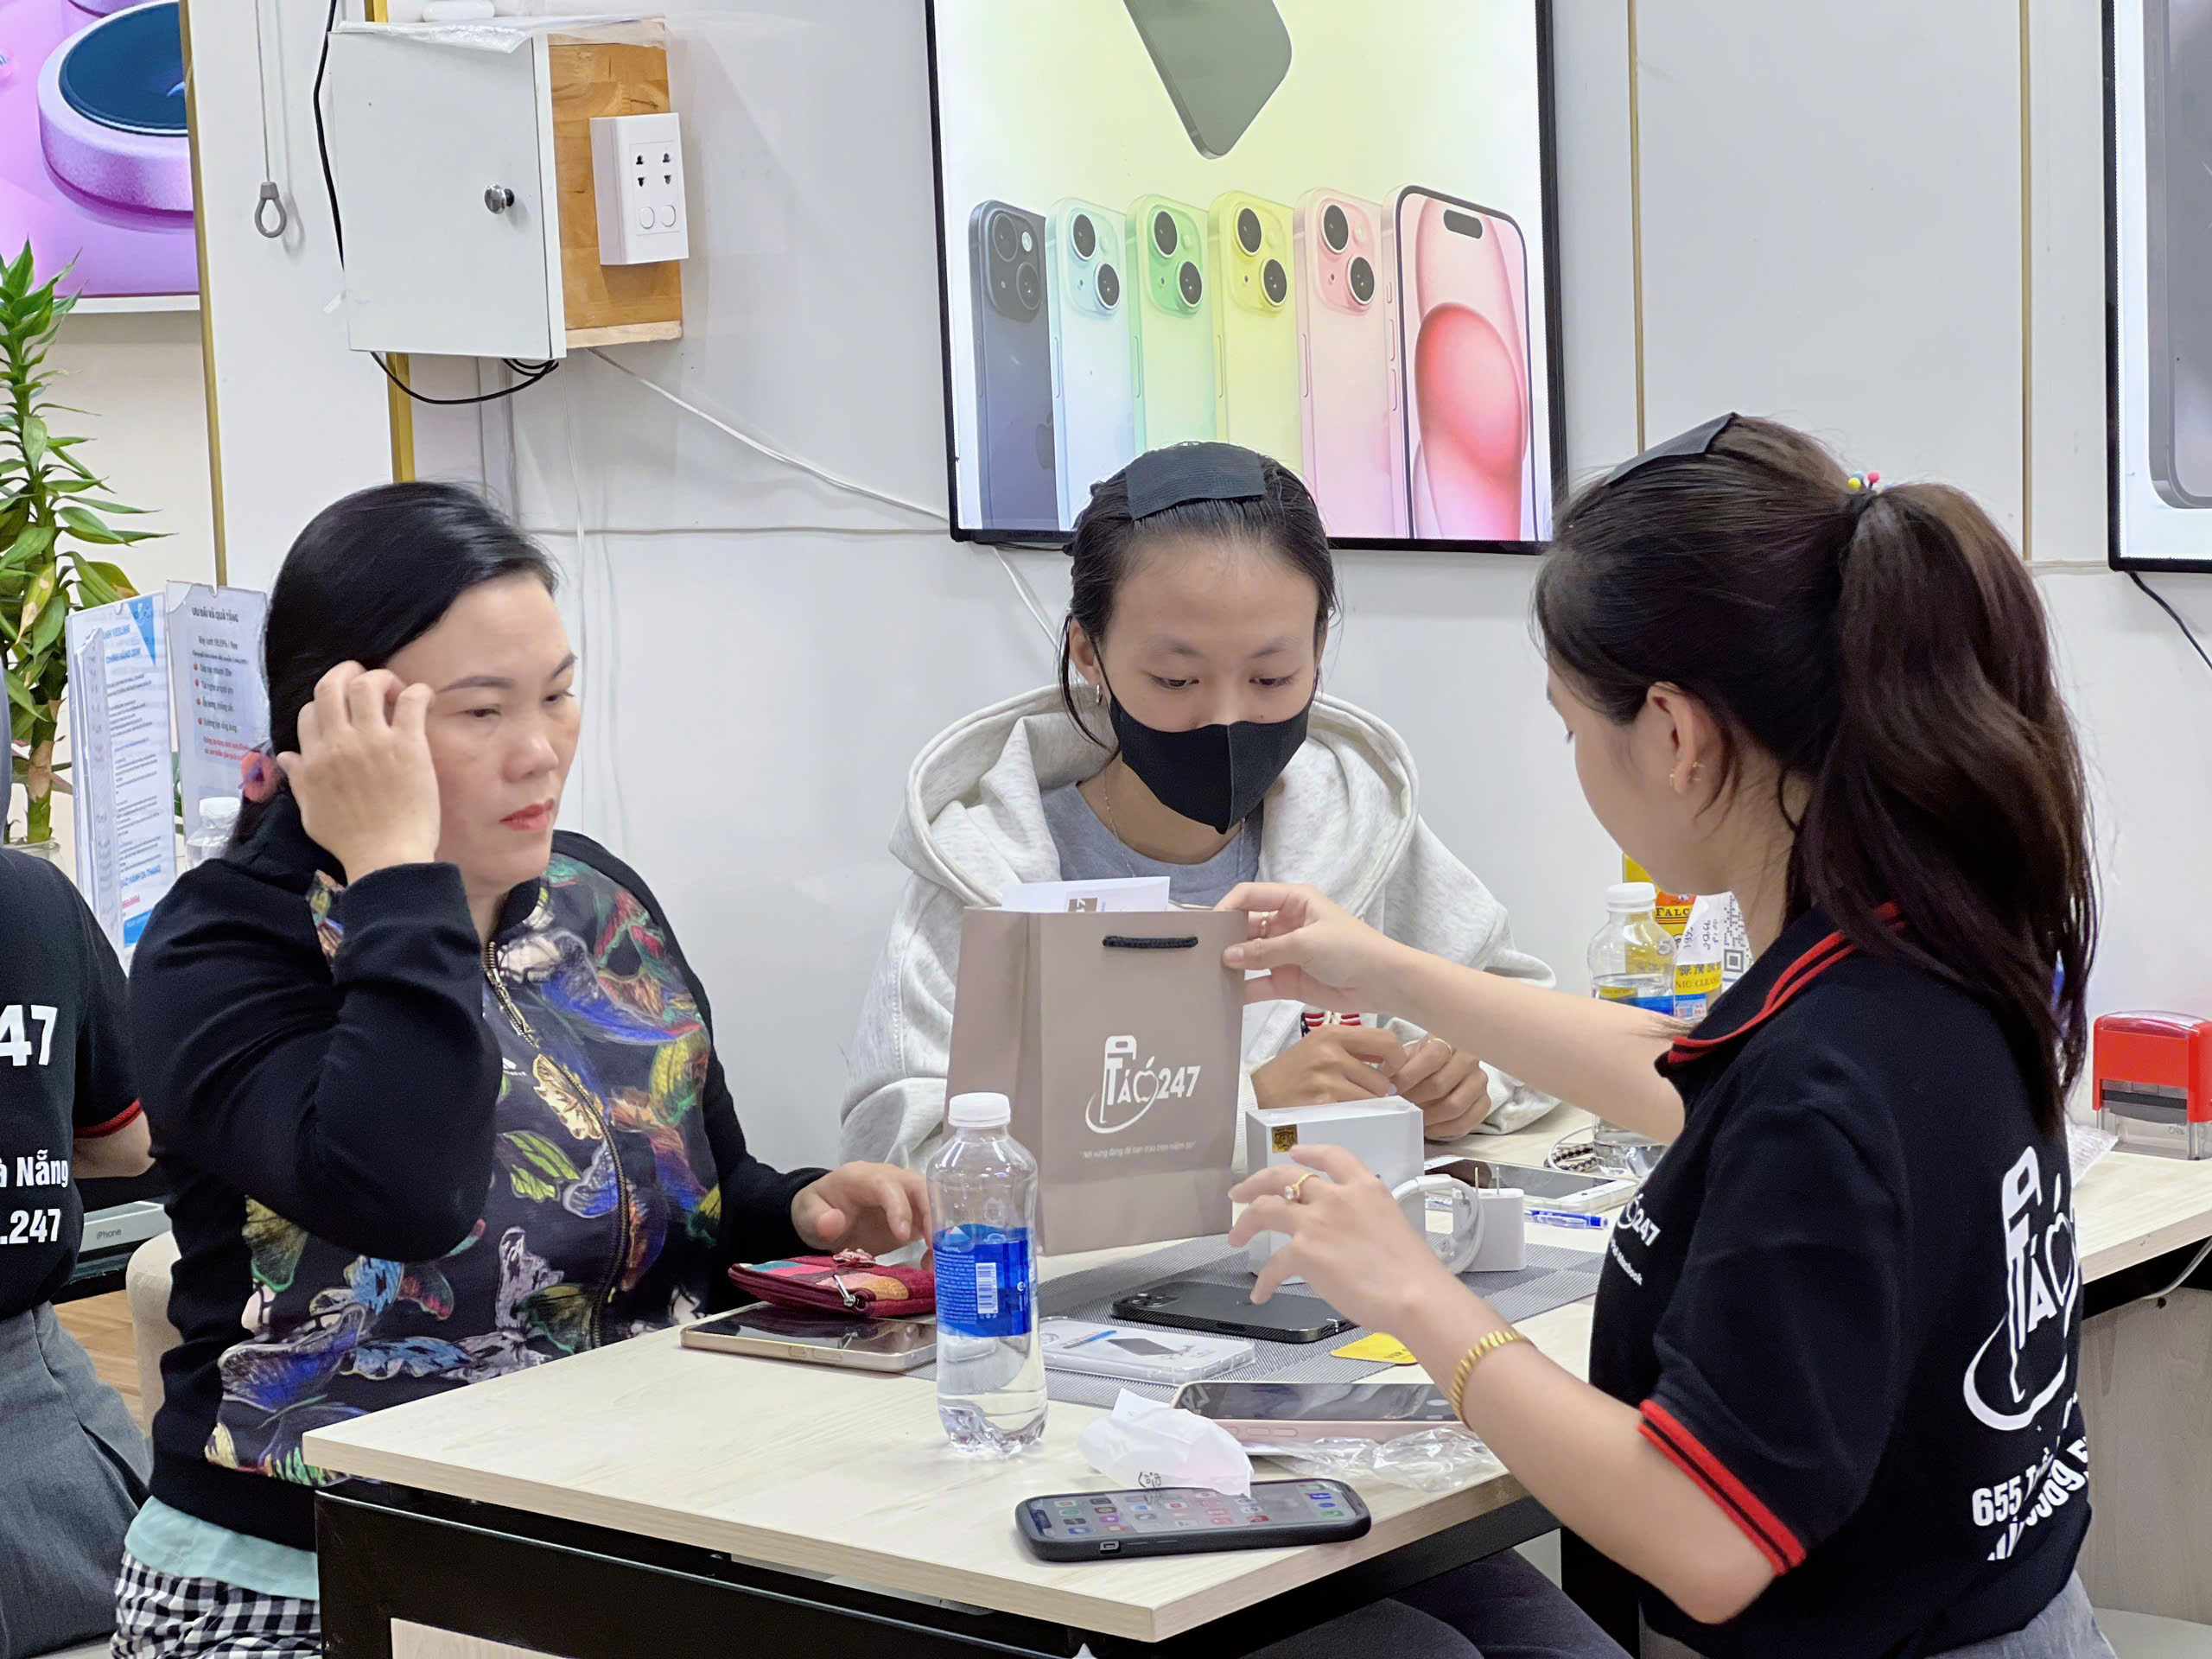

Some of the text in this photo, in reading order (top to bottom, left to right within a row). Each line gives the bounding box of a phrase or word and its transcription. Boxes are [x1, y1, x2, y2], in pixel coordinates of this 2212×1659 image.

[16, 1149, 69, 1188] Nẵng
[97, 1229, 122, 1239] iPhone
[1972, 1475, 2023, 1527] 655
